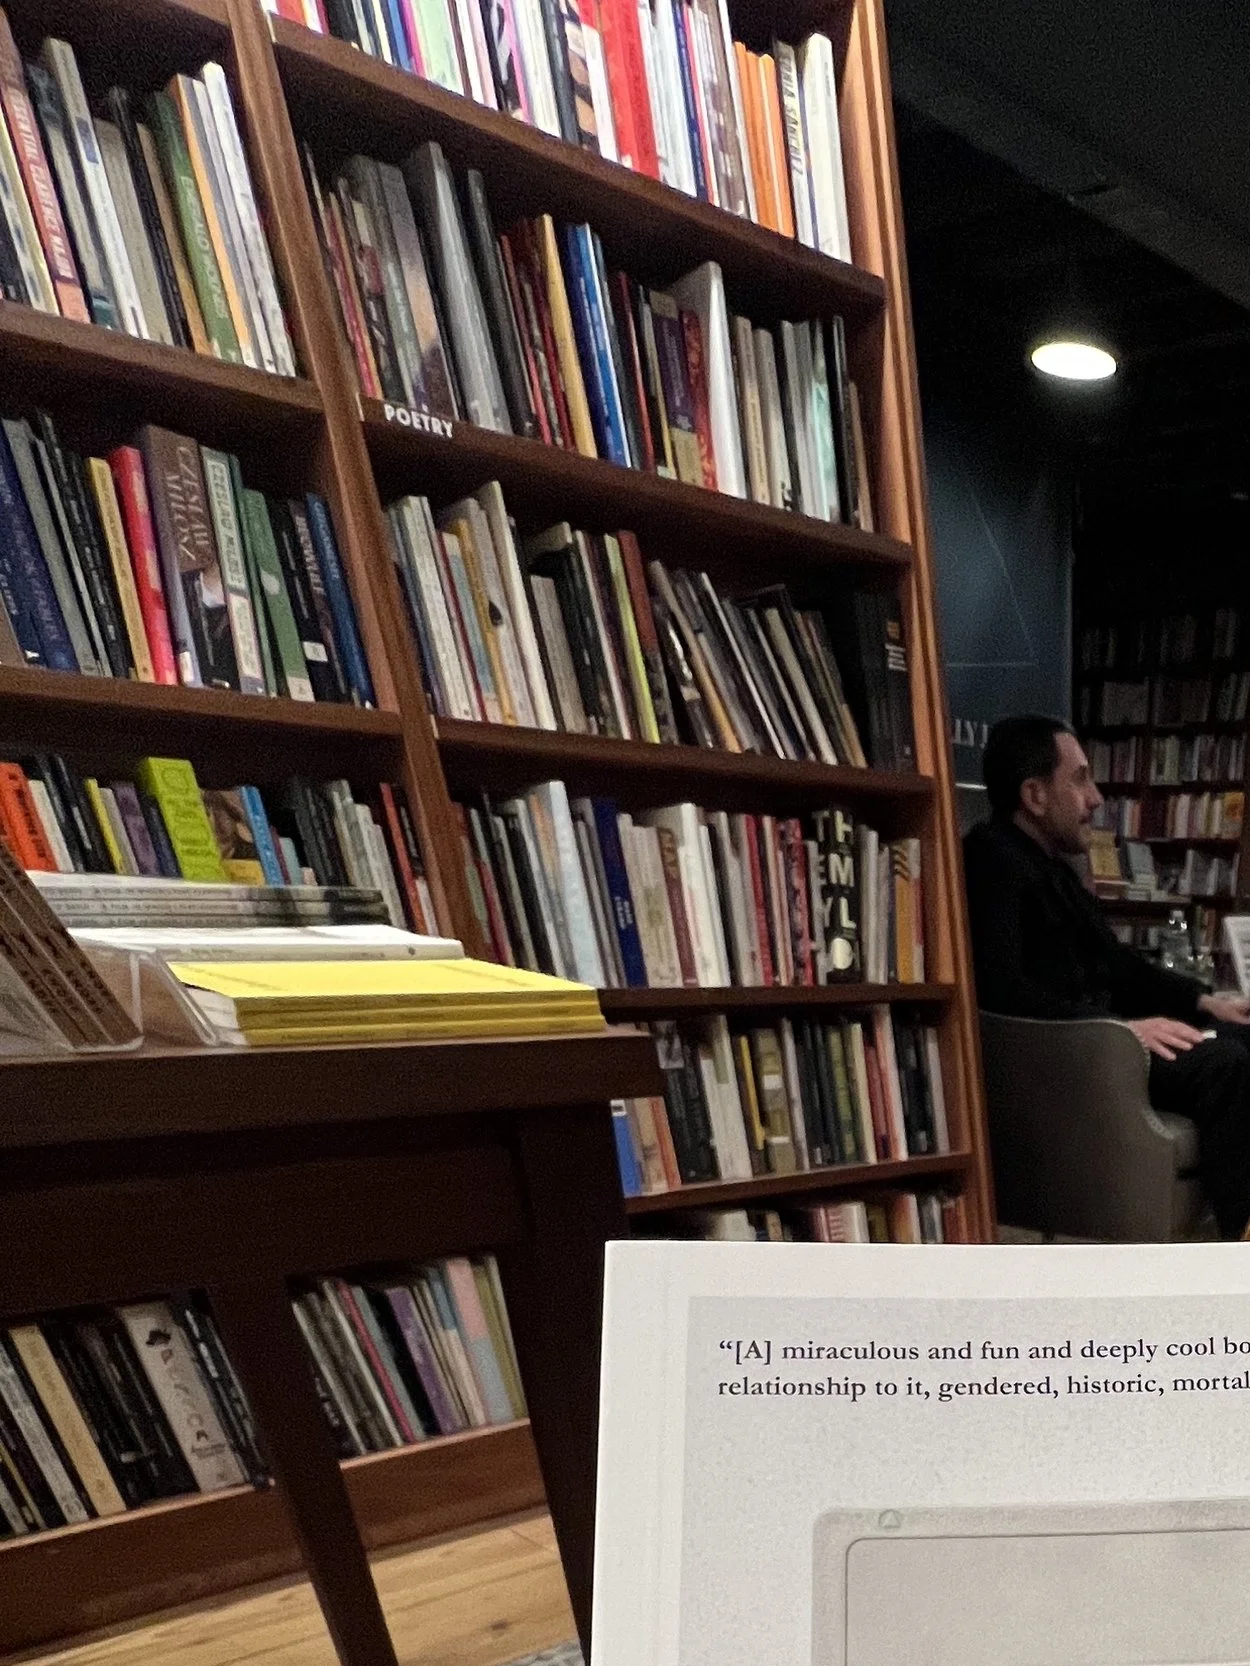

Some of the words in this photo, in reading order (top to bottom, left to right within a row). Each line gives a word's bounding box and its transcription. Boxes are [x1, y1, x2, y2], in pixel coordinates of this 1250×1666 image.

[784, 104, 804, 176] SANCHEZ
[384, 403, 453, 438] POETRY
[782, 1341, 919, 1360] miraculous
[928, 1341, 972, 1359] and
[980, 1341, 1019, 1359] fun
[1028, 1340, 1072, 1359] and
[1081, 1339, 1158, 1364] deeply
[1167, 1337, 1216, 1356] cool
[719, 1376, 866, 1402] relationship
[875, 1382, 897, 1395] to
[906, 1377, 930, 1400] it,
[938, 1376, 1058, 1402] gendered,
[1067, 1374, 1164, 1396] historic,
[1173, 1370, 1250, 1393] mortal
